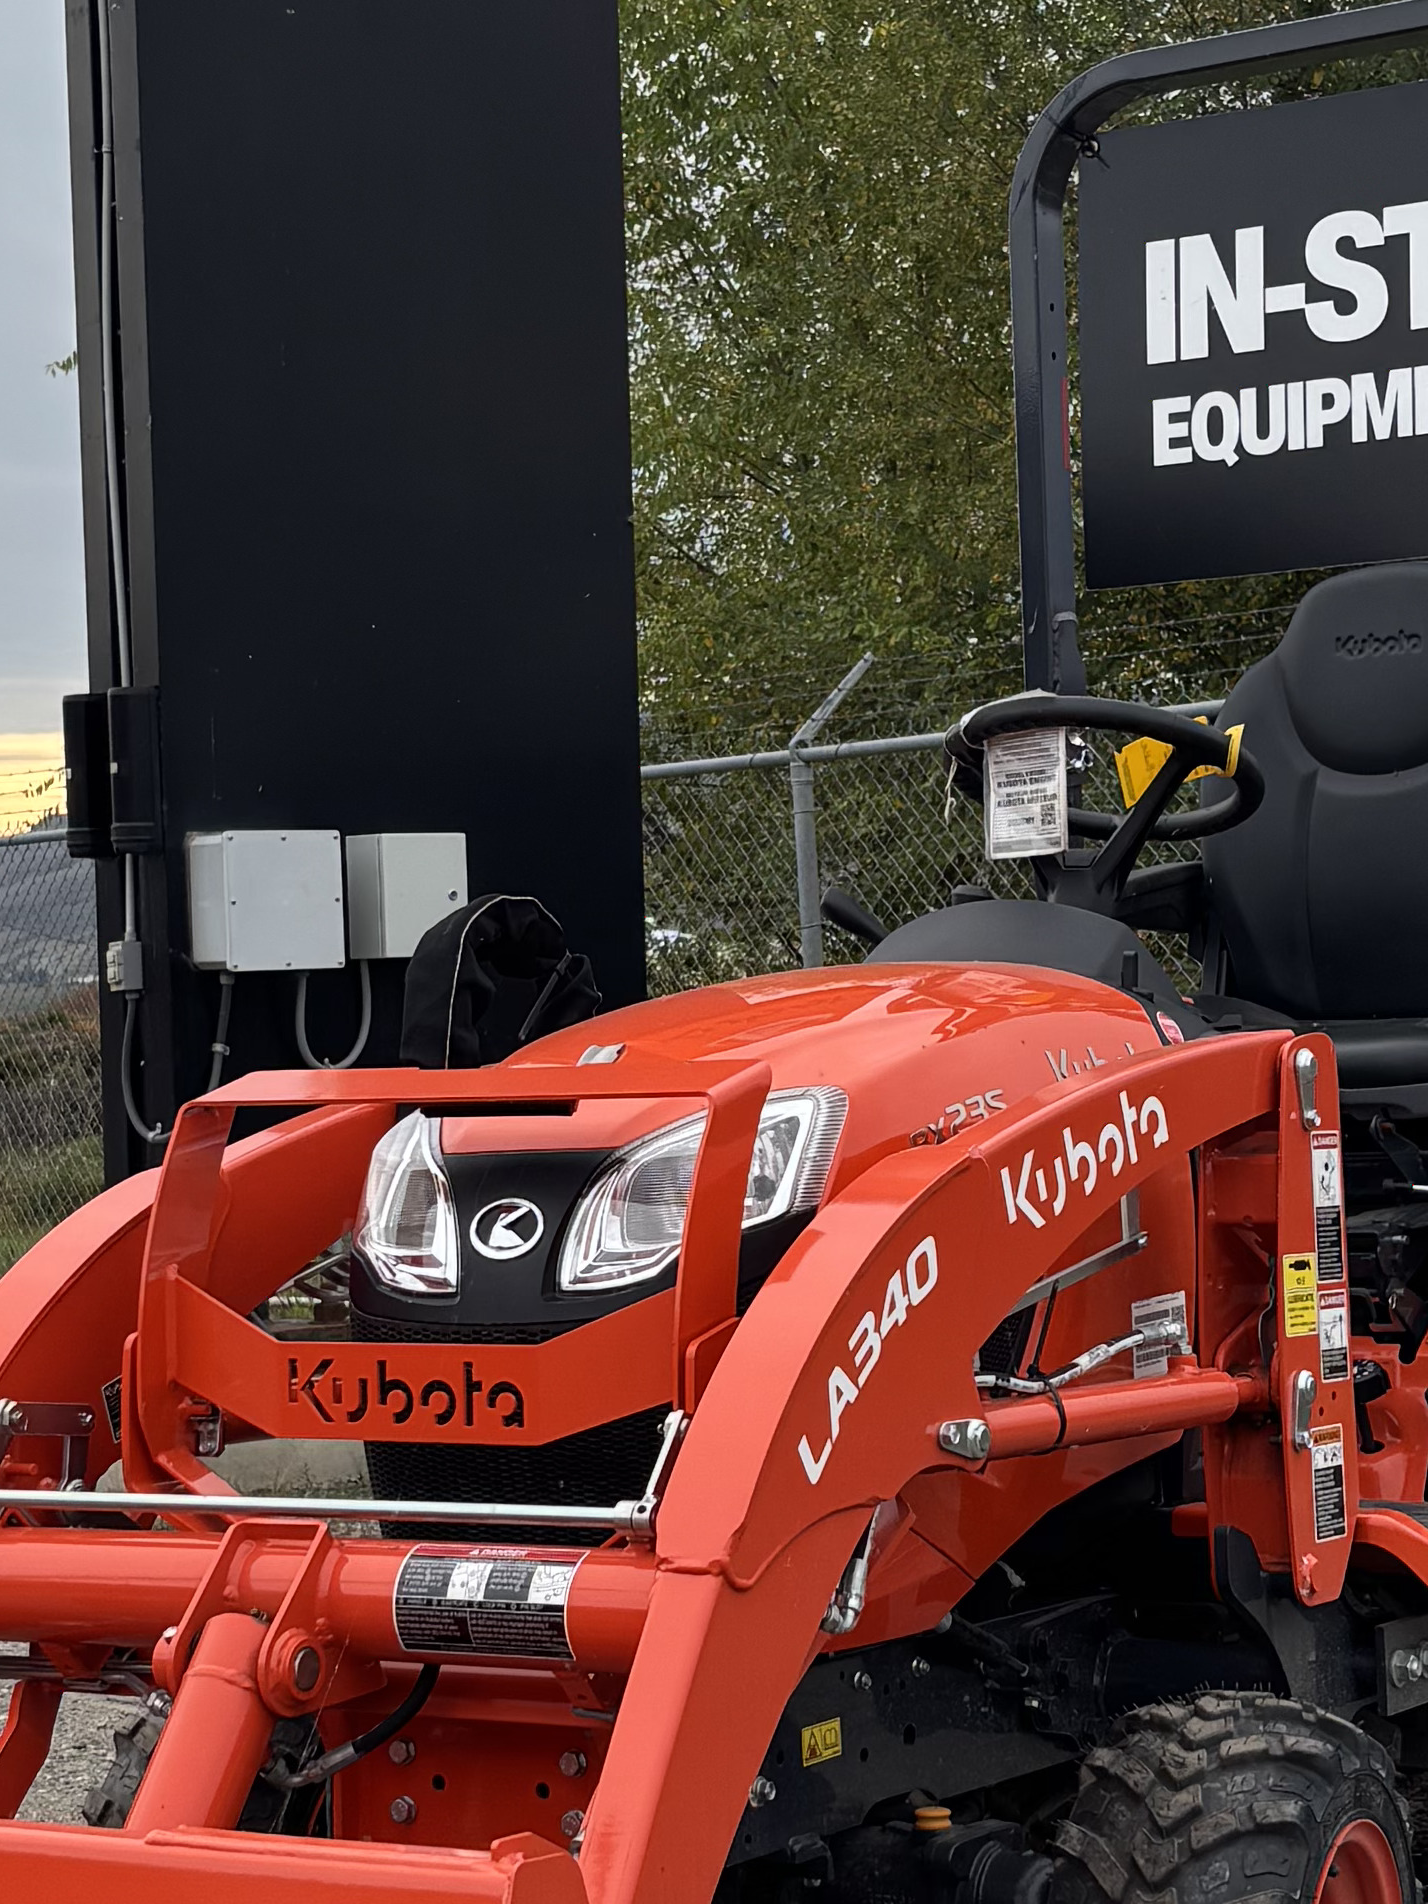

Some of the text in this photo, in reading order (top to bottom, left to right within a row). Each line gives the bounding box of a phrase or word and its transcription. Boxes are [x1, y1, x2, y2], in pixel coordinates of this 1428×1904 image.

[1334, 628, 1423, 660] Kubota
[999, 1089, 1170, 1230] Kubota
[287, 1356, 525, 1430] Kubota
[798, 1234, 940, 1486] LA340
